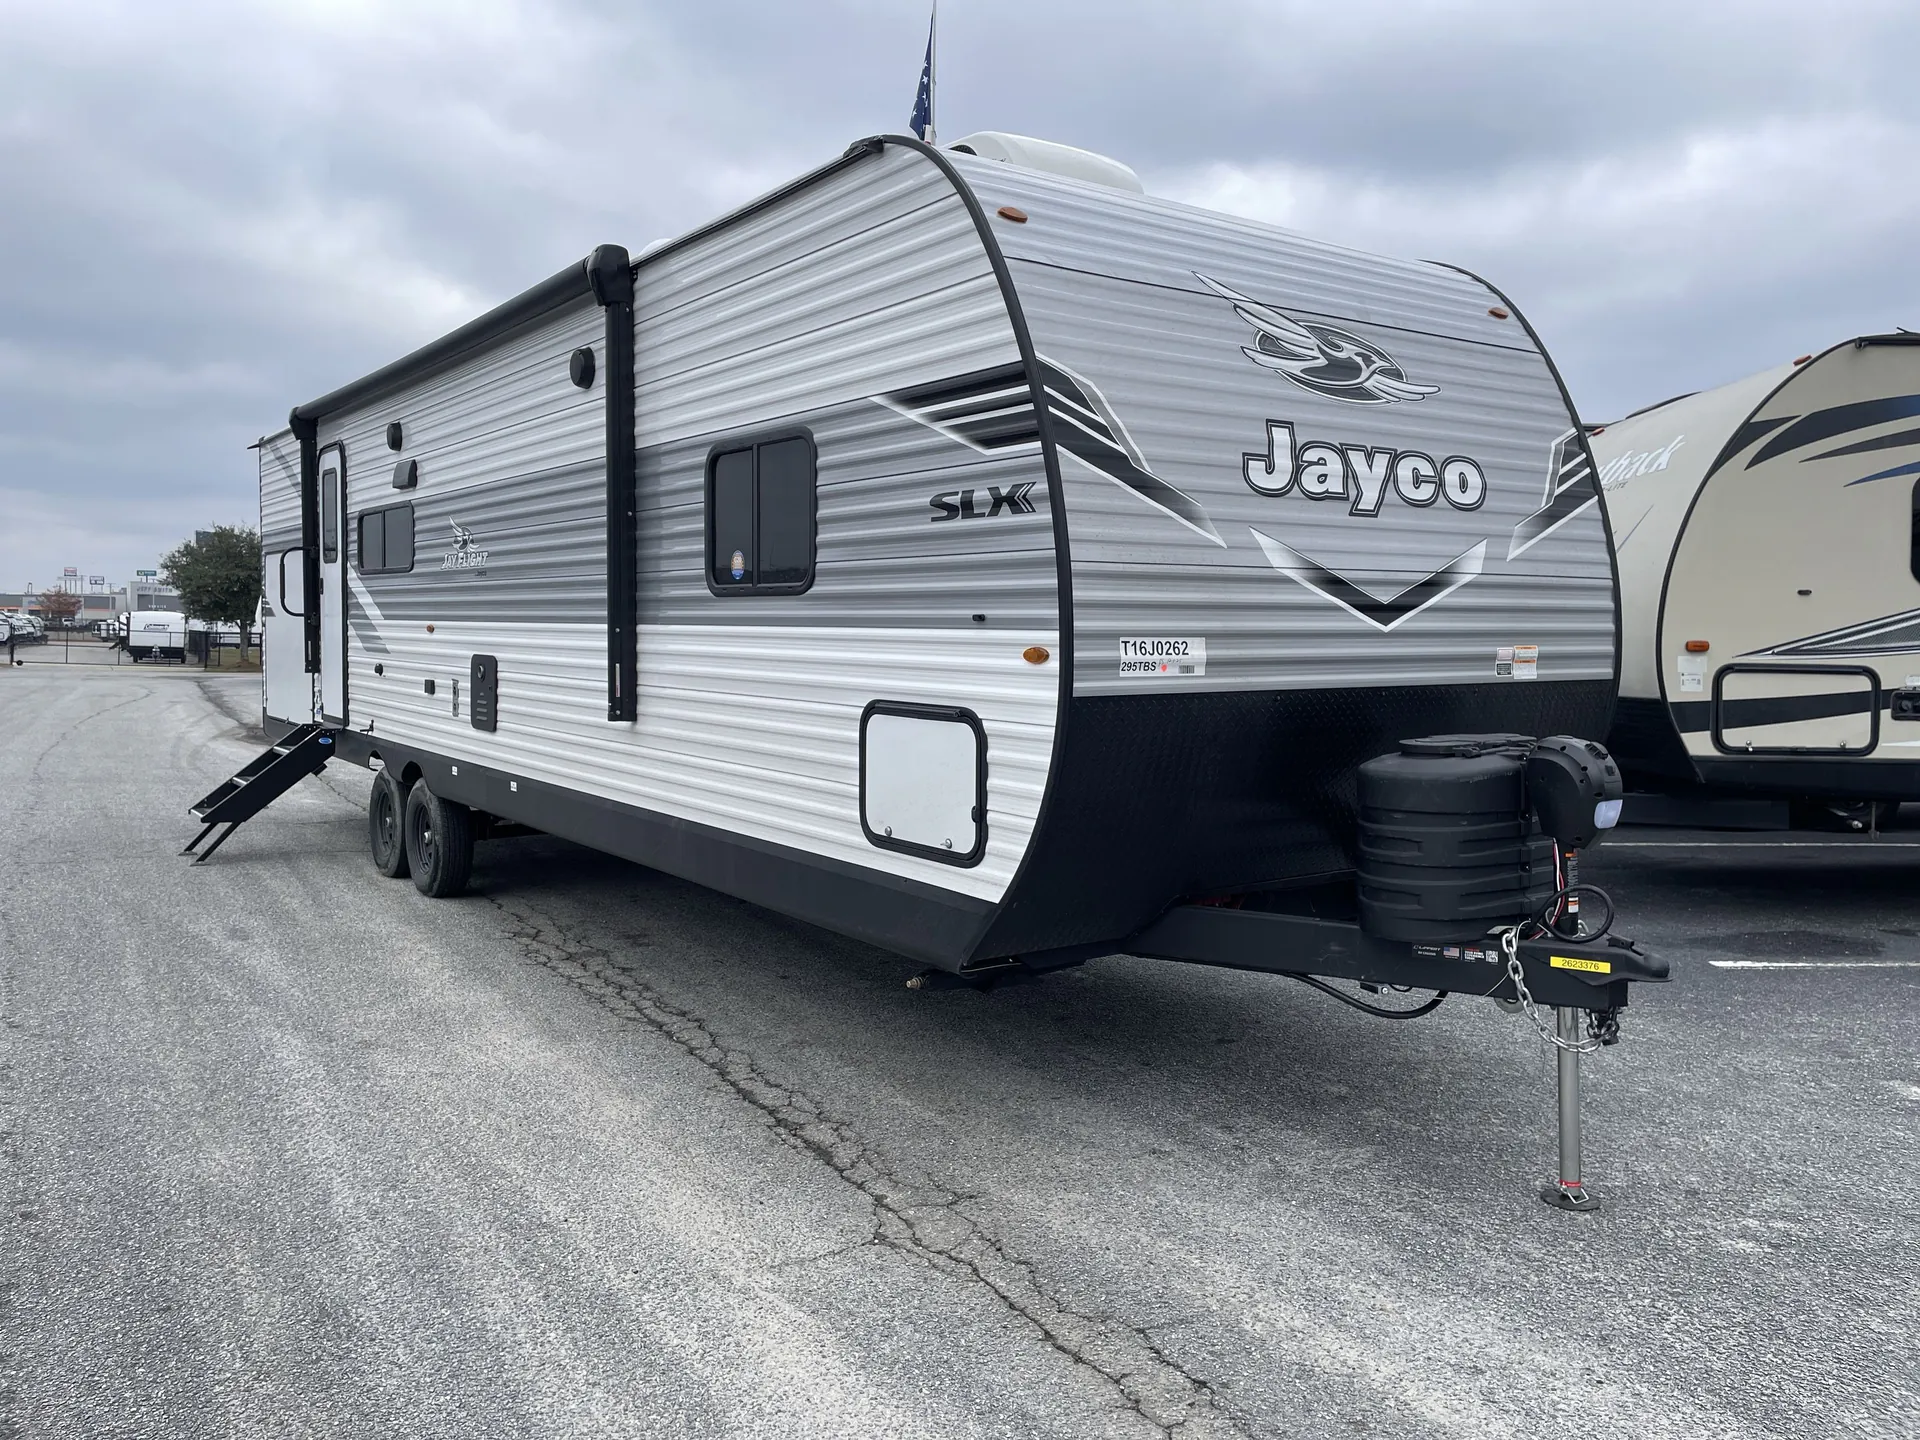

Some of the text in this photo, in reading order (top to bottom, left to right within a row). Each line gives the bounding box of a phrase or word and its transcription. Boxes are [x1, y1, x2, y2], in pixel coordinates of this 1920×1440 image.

[1242, 418, 1488, 518] Jayco
[929, 481, 1037, 522] SLX
[441, 551, 488, 570] JAY FLIGHT
[1121, 640, 1189, 656] T16J0262
[1121, 661, 1157, 672] 295TBS
[1561, 959, 1600, 971] 2623376
